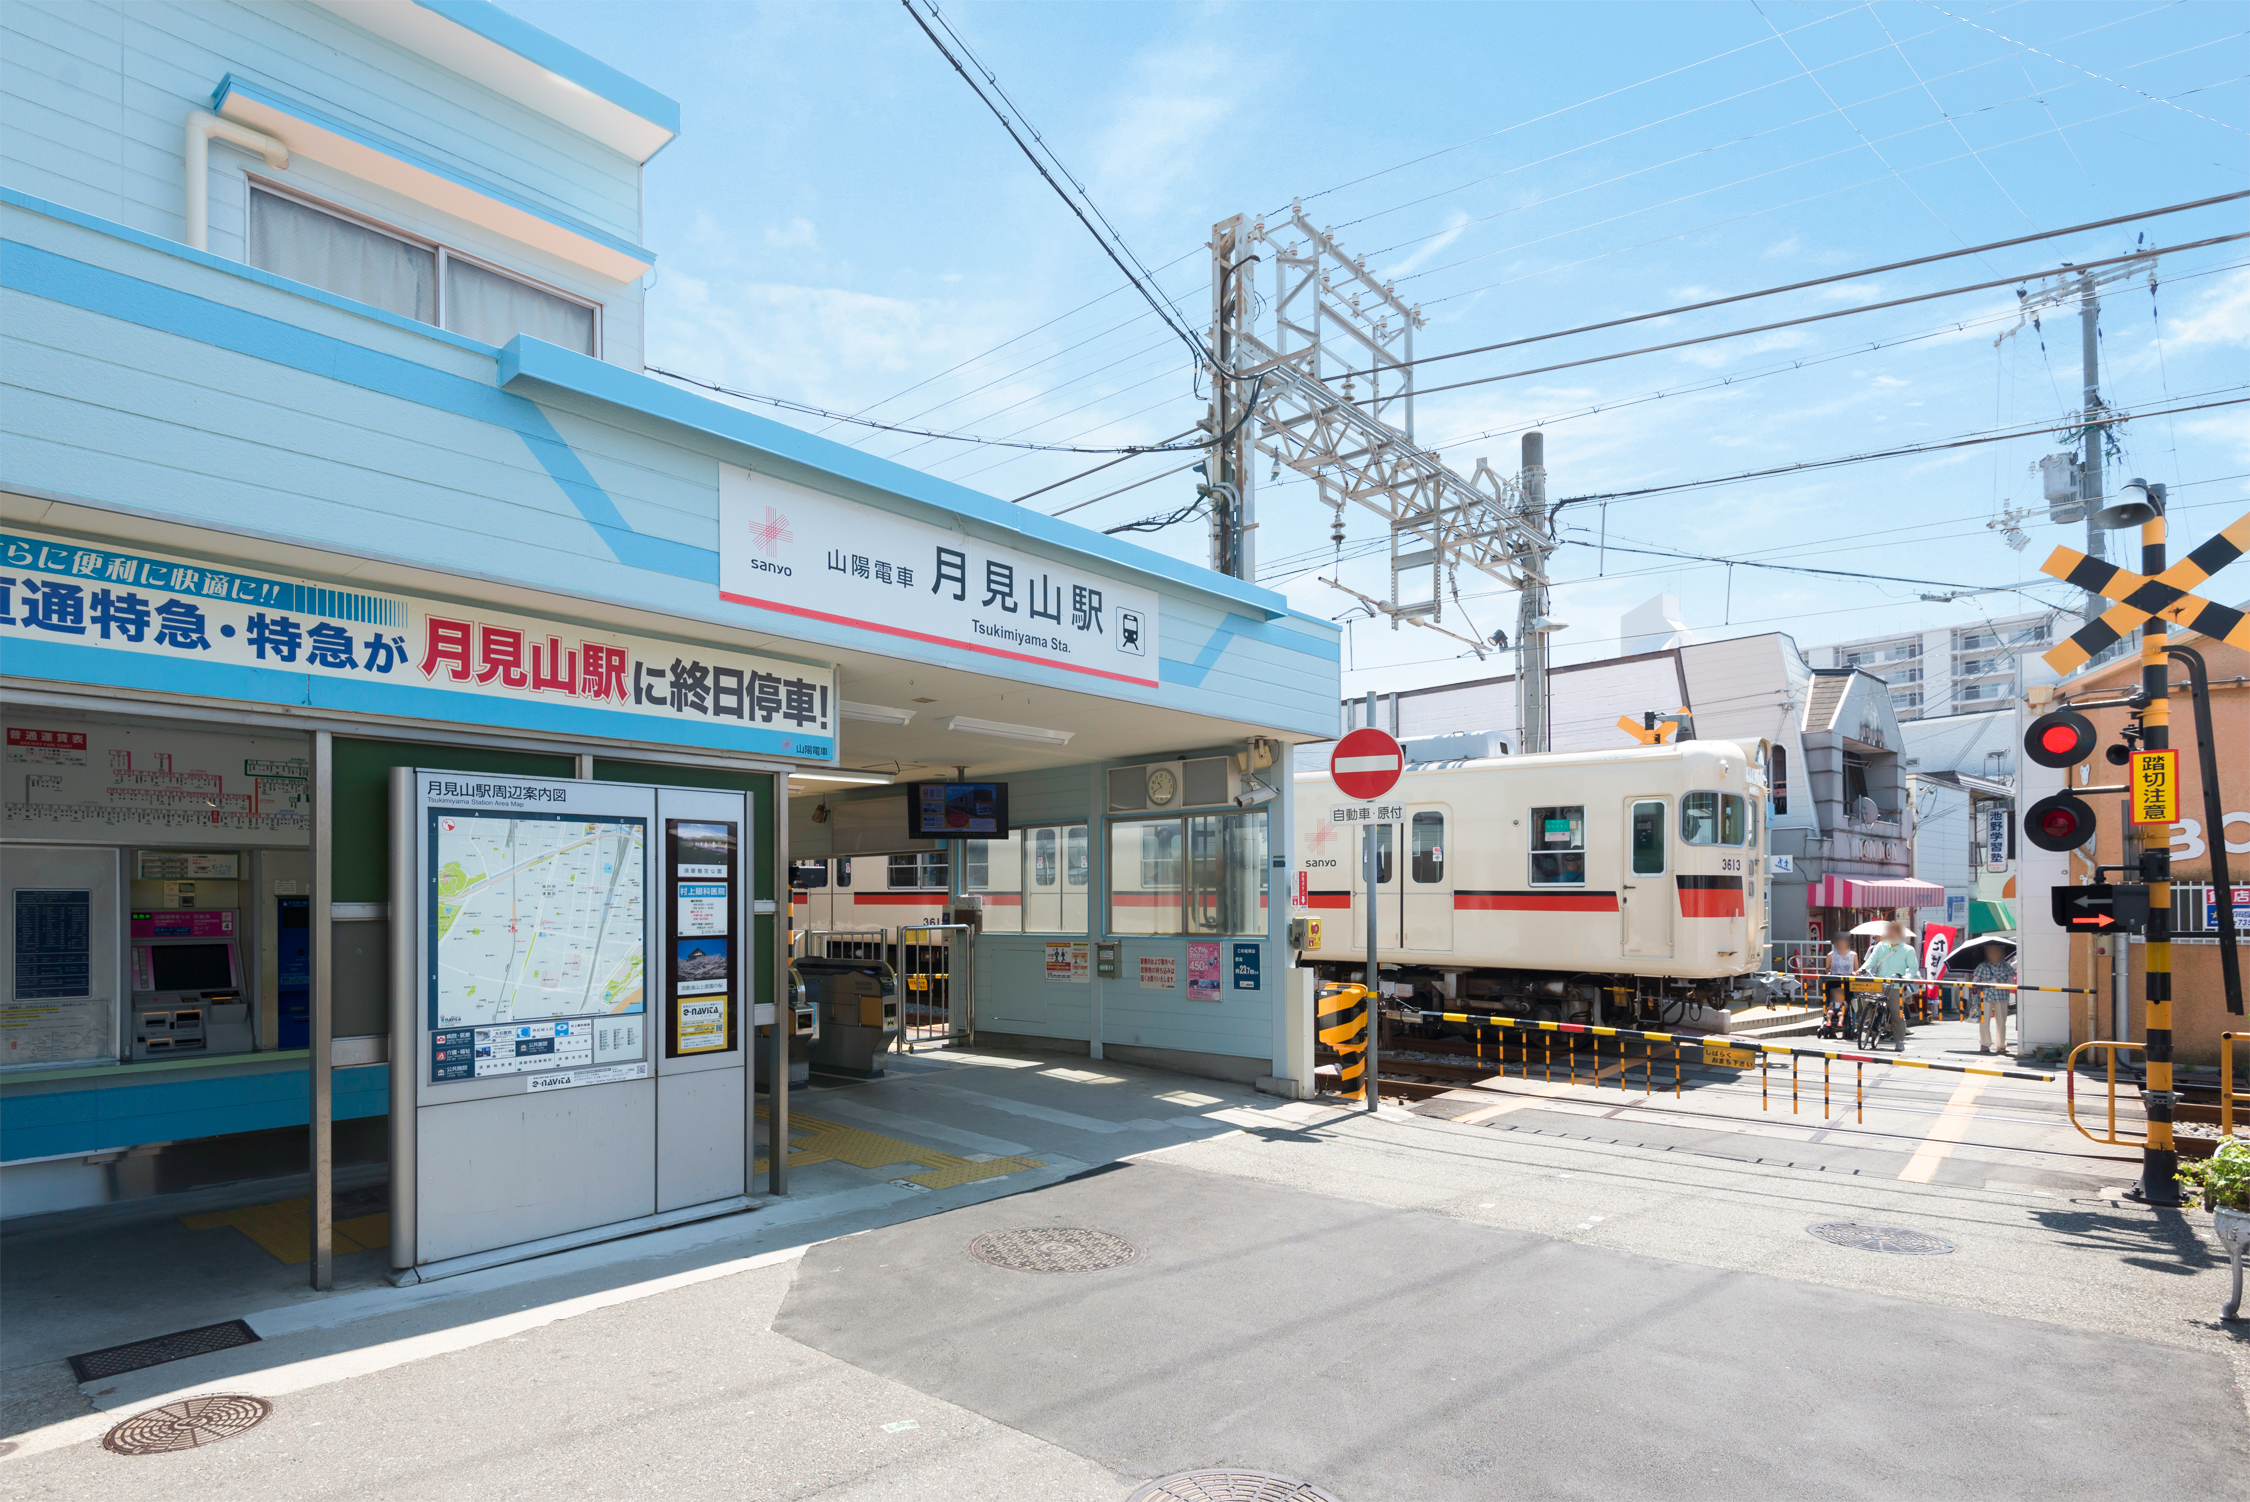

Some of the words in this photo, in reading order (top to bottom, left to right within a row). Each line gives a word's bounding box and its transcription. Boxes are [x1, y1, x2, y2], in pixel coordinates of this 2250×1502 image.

[0, 541, 281, 604] らに便利に快適に!!
[750, 557, 793, 577] sanyo
[827, 548, 915, 589] 山陽電車
[930, 545, 1104, 636] 月見山駅
[971, 619, 1048, 650] Tsukimiyama
[1050, 634, 1072, 654] Sta.
[9, 729, 84, 744] 普通運賃表
[796, 744, 829, 757] 山陽電車
[427, 780, 567, 803] 月見山駅周辺案内図
[2142, 755, 2167, 820] 踏切注意
[427, 796, 470, 806] Tsukimiyama
[471, 799, 493, 807] Station
[1332, 805, 1403, 822] 自動車・原付
[1990, 811, 2004, 863] 池野学習塾
[1305, 857, 1337, 868] sanyo
[1721, 857, 1742, 872] 3613
[679, 886, 726, 896] 村上眼科医院
[1705, 1049, 1732, 1059] しばらく
[1711, 1057, 1753, 1068] おまち下さい
